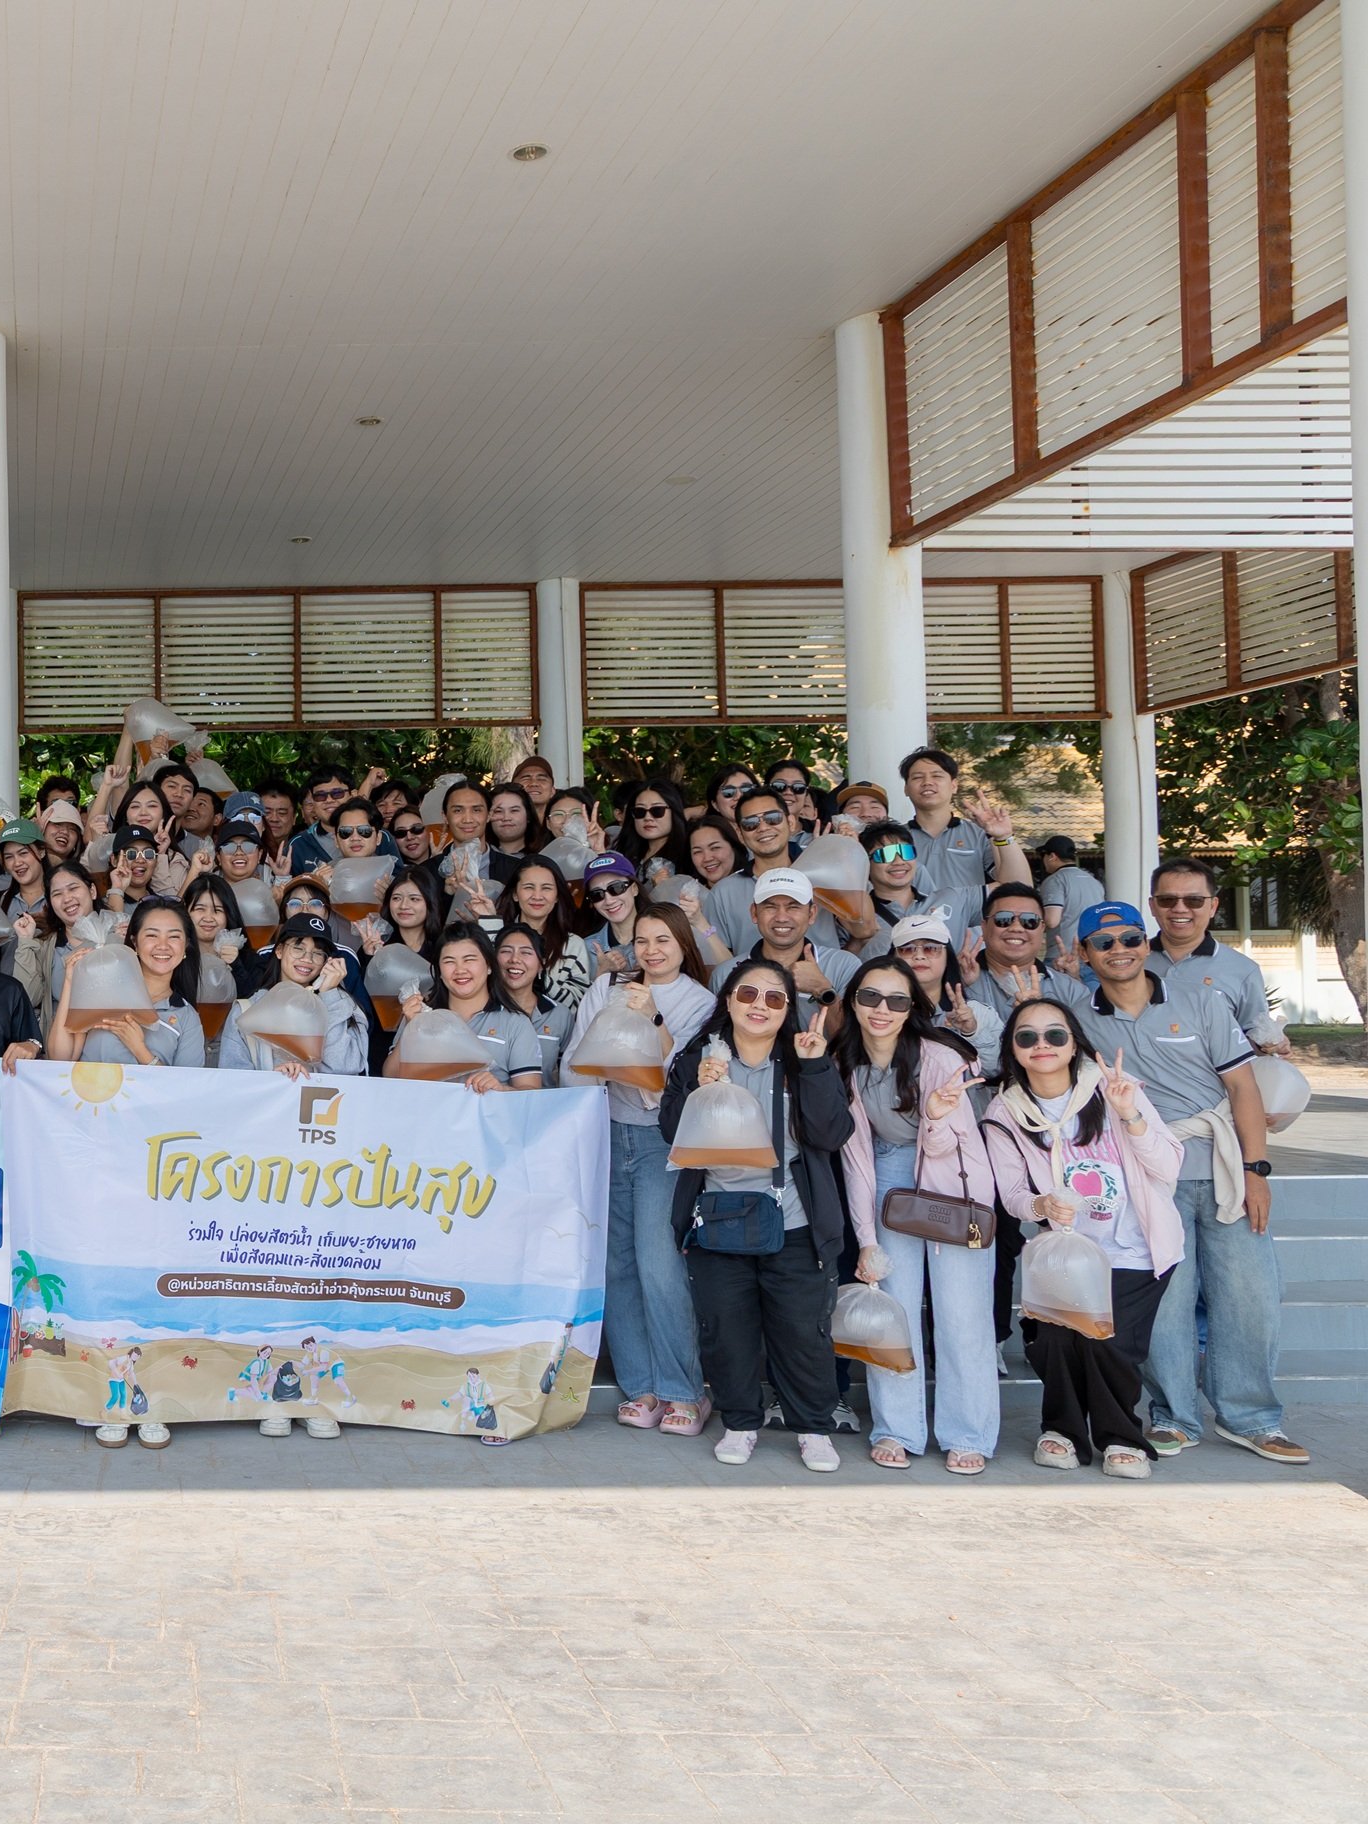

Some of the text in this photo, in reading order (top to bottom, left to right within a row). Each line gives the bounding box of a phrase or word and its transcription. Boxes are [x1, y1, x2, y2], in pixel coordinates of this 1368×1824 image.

[298, 1128, 337, 1146] TPS
[144, 1131, 497, 1234] โครงการปันสุข
[188, 1221, 416, 1251] ร่วมใจ ปล่อยสัตว์น้ำ เก็บขยะชายหาด
[220, 1246, 382, 1271] เพื่อสังคมและสิ่งแวดล้อม
[167, 1276, 452, 1306] @หน่วยสาธิตการเลี้ยงสัตว์น้ำอ่าวคุ้งกระเบน จันทบุรี
